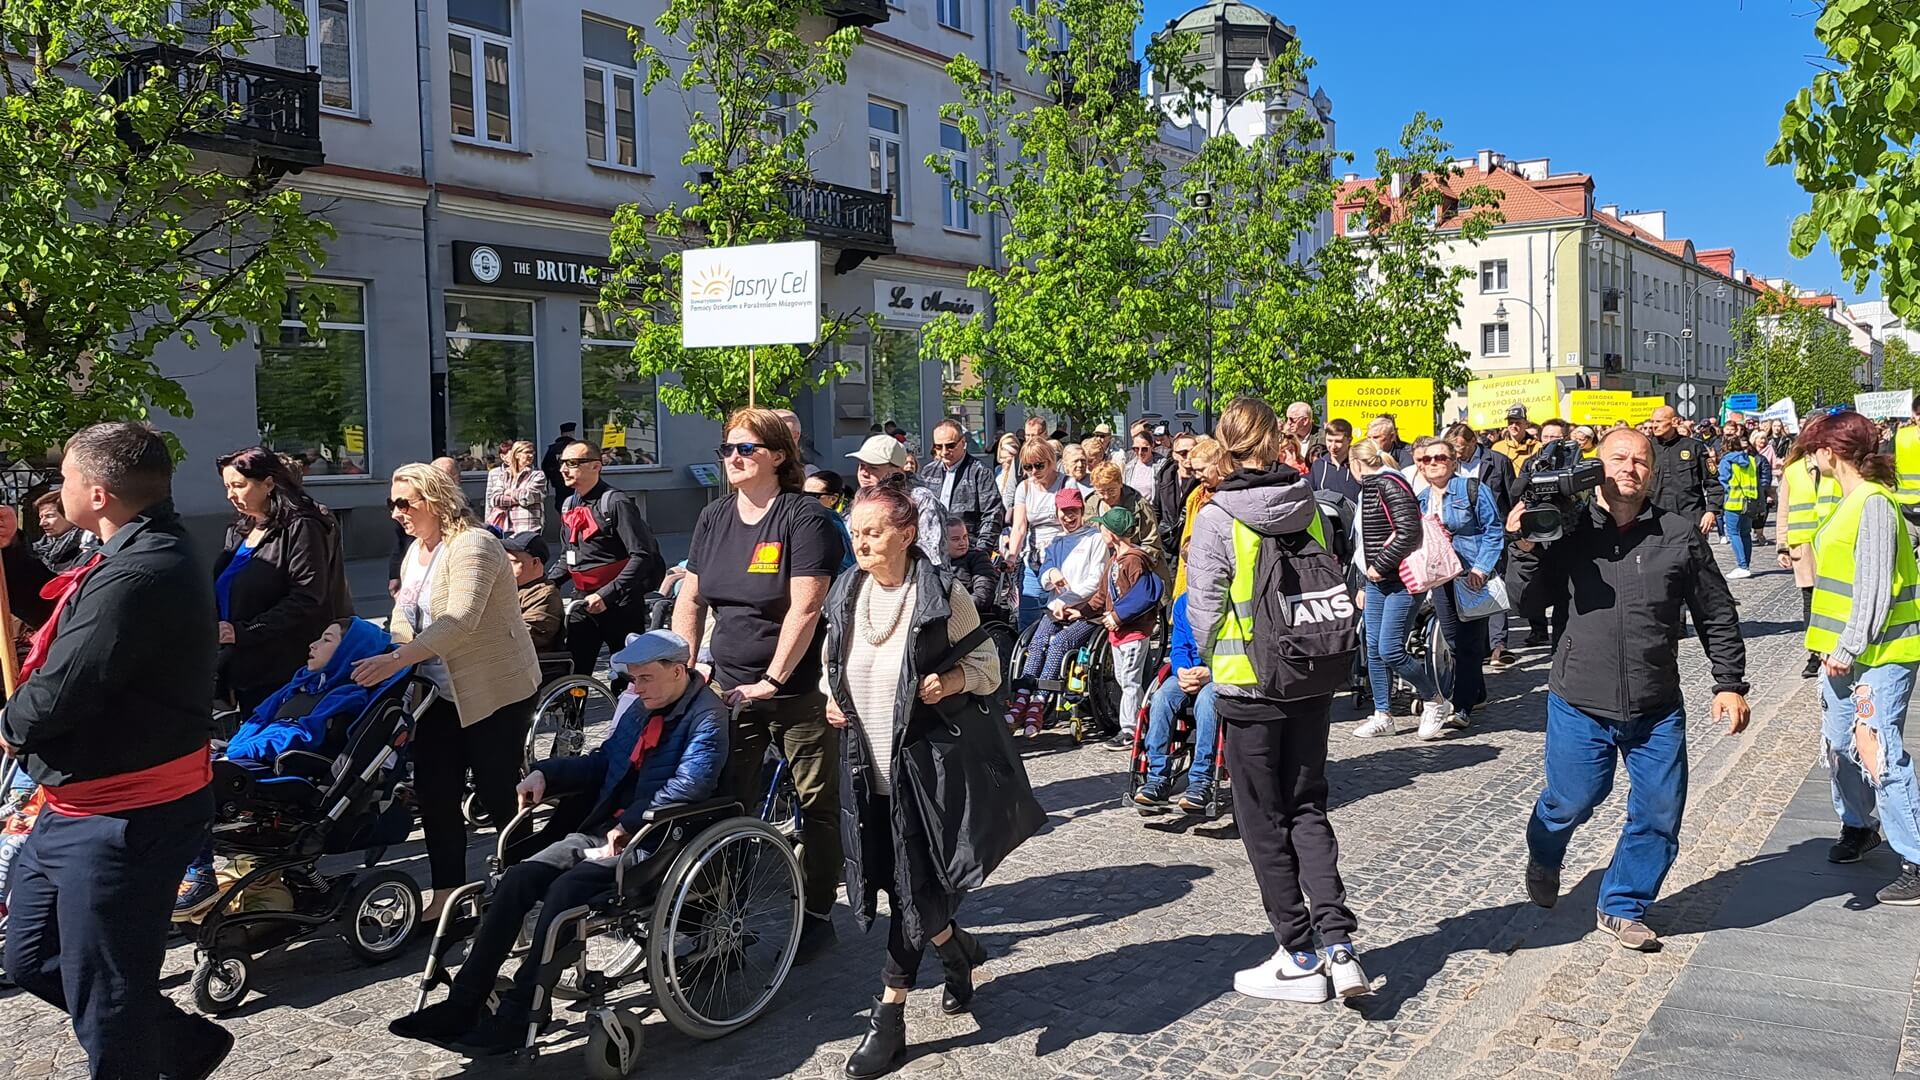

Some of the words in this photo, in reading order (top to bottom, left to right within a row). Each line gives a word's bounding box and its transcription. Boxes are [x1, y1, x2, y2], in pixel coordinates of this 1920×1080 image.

[513, 261, 531, 275] THE
[536, 259, 598, 285] BRUTAL
[727, 275, 777, 302] Jasny
[781, 270, 808, 294] Cel
[1357, 386, 1401, 395] OŚRODEK
[1495, 388, 1526, 397] SZKOŁA
[1333, 399, 1387, 407] DZIENNEGO
[1390, 399, 1428, 407] POBYTU
[1277, 583, 1355, 627] VANS
